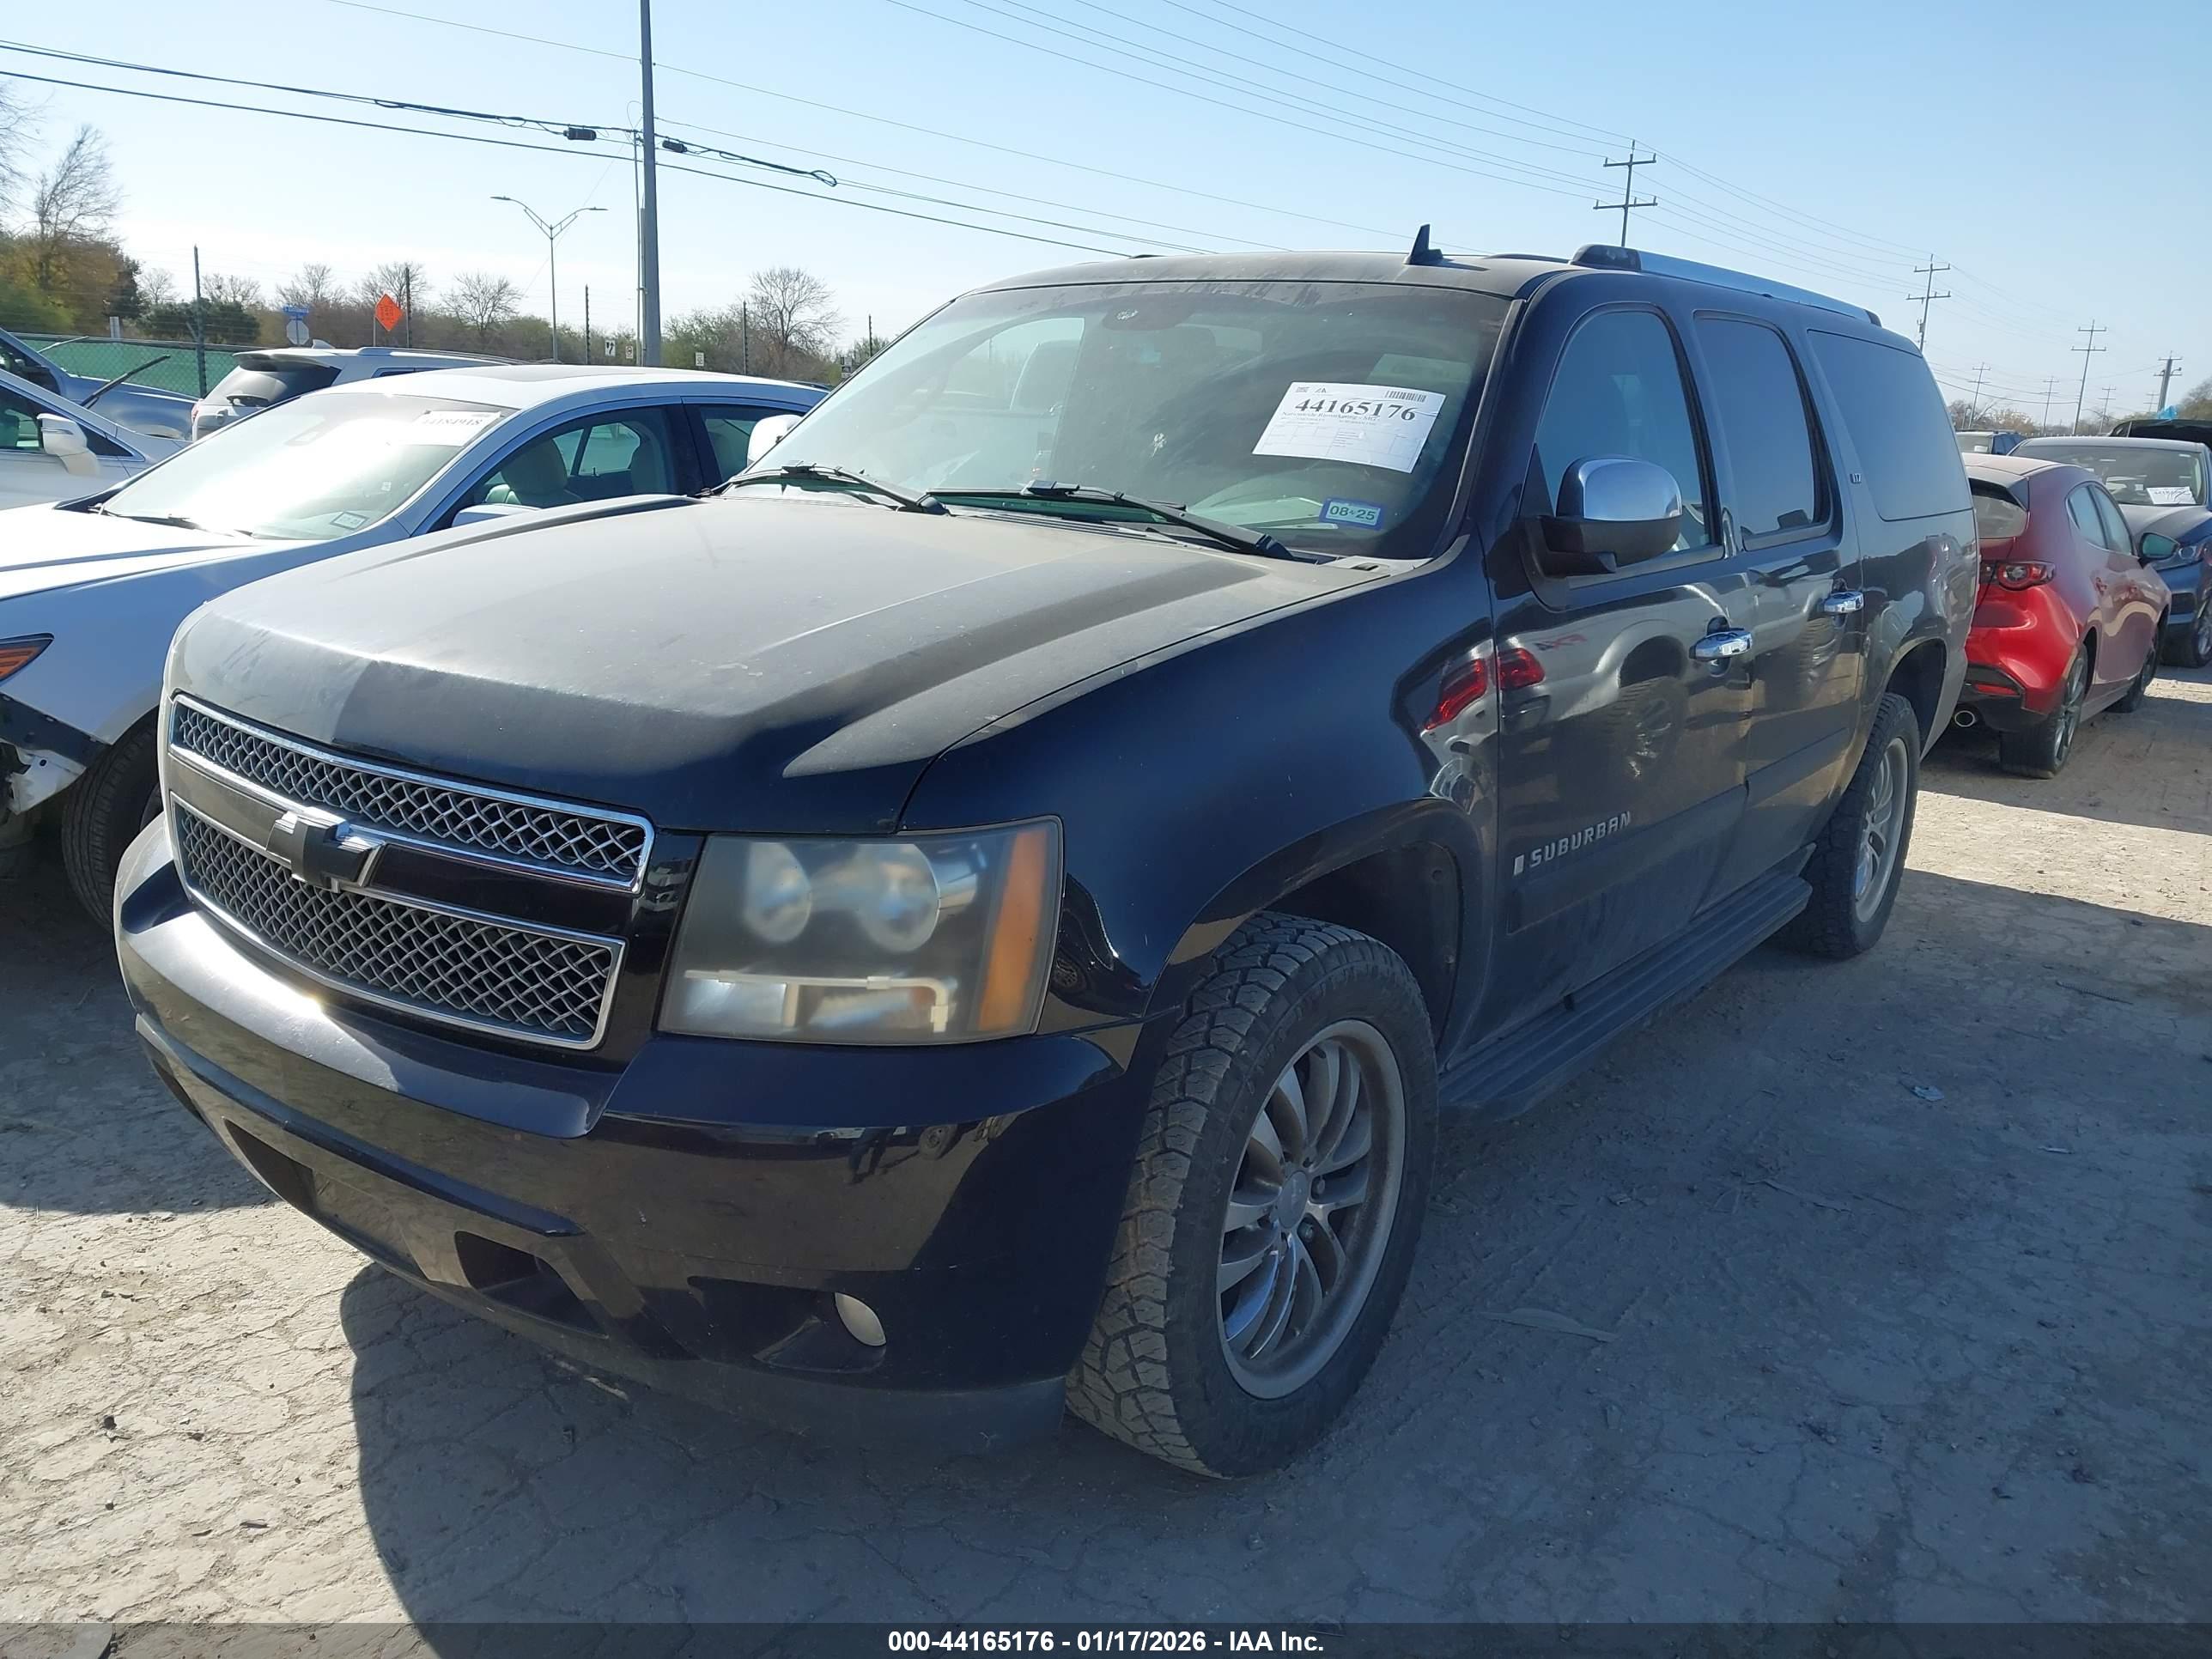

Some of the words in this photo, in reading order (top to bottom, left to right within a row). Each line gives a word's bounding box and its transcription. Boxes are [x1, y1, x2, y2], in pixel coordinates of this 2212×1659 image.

[1295, 398, 1419, 421] 44165176
[1330, 505, 1349, 517] 08
[1355, 508, 1376, 520] 25
[1529, 811, 1632, 868] SUBURBAN
